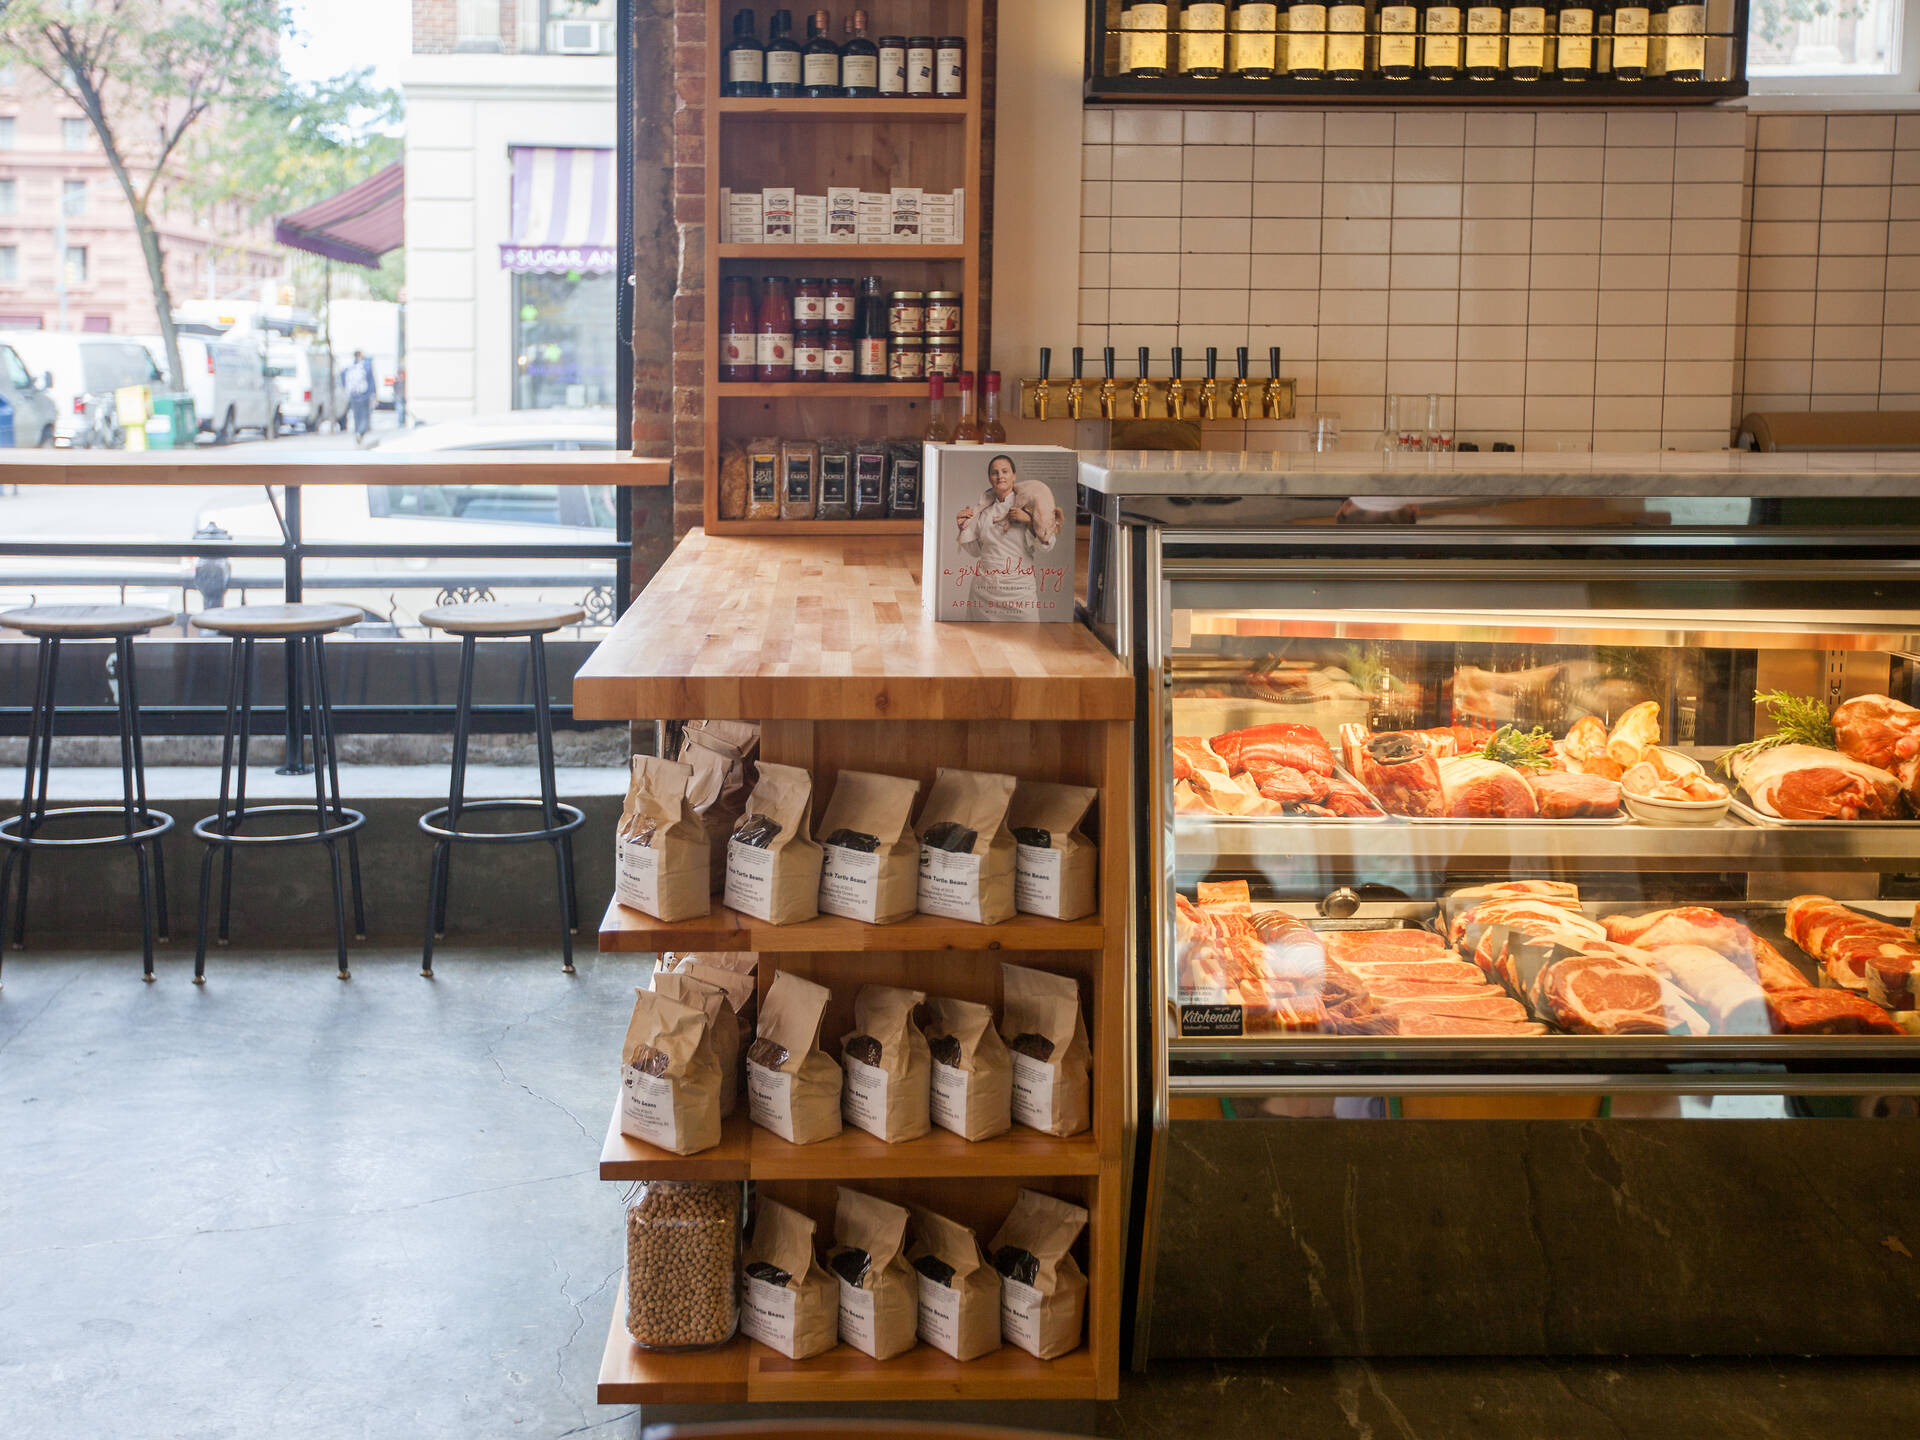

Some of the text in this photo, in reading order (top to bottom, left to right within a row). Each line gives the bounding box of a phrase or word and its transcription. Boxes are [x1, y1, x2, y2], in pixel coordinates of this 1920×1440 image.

[516, 249, 584, 268] SUGAR
[955, 559, 982, 586] girl
[983, 556, 1012, 576] and
[1014, 556, 1037, 578] her
[952, 600, 1056, 609] APRIL BLOOMFIELD
[736, 870, 748, 878] Turtle
[749, 873, 764, 882] Beans
[834, 872, 849, 881] Turtle
[850, 876, 867, 884] Beans
[933, 875, 948, 884] Turtle
[1032, 872, 1050, 881] Beans
[1183, 1008, 1241, 1023] Kitchenall
[641, 1100, 657, 1109] Beans
[767, 1310, 785, 1319] Beans
